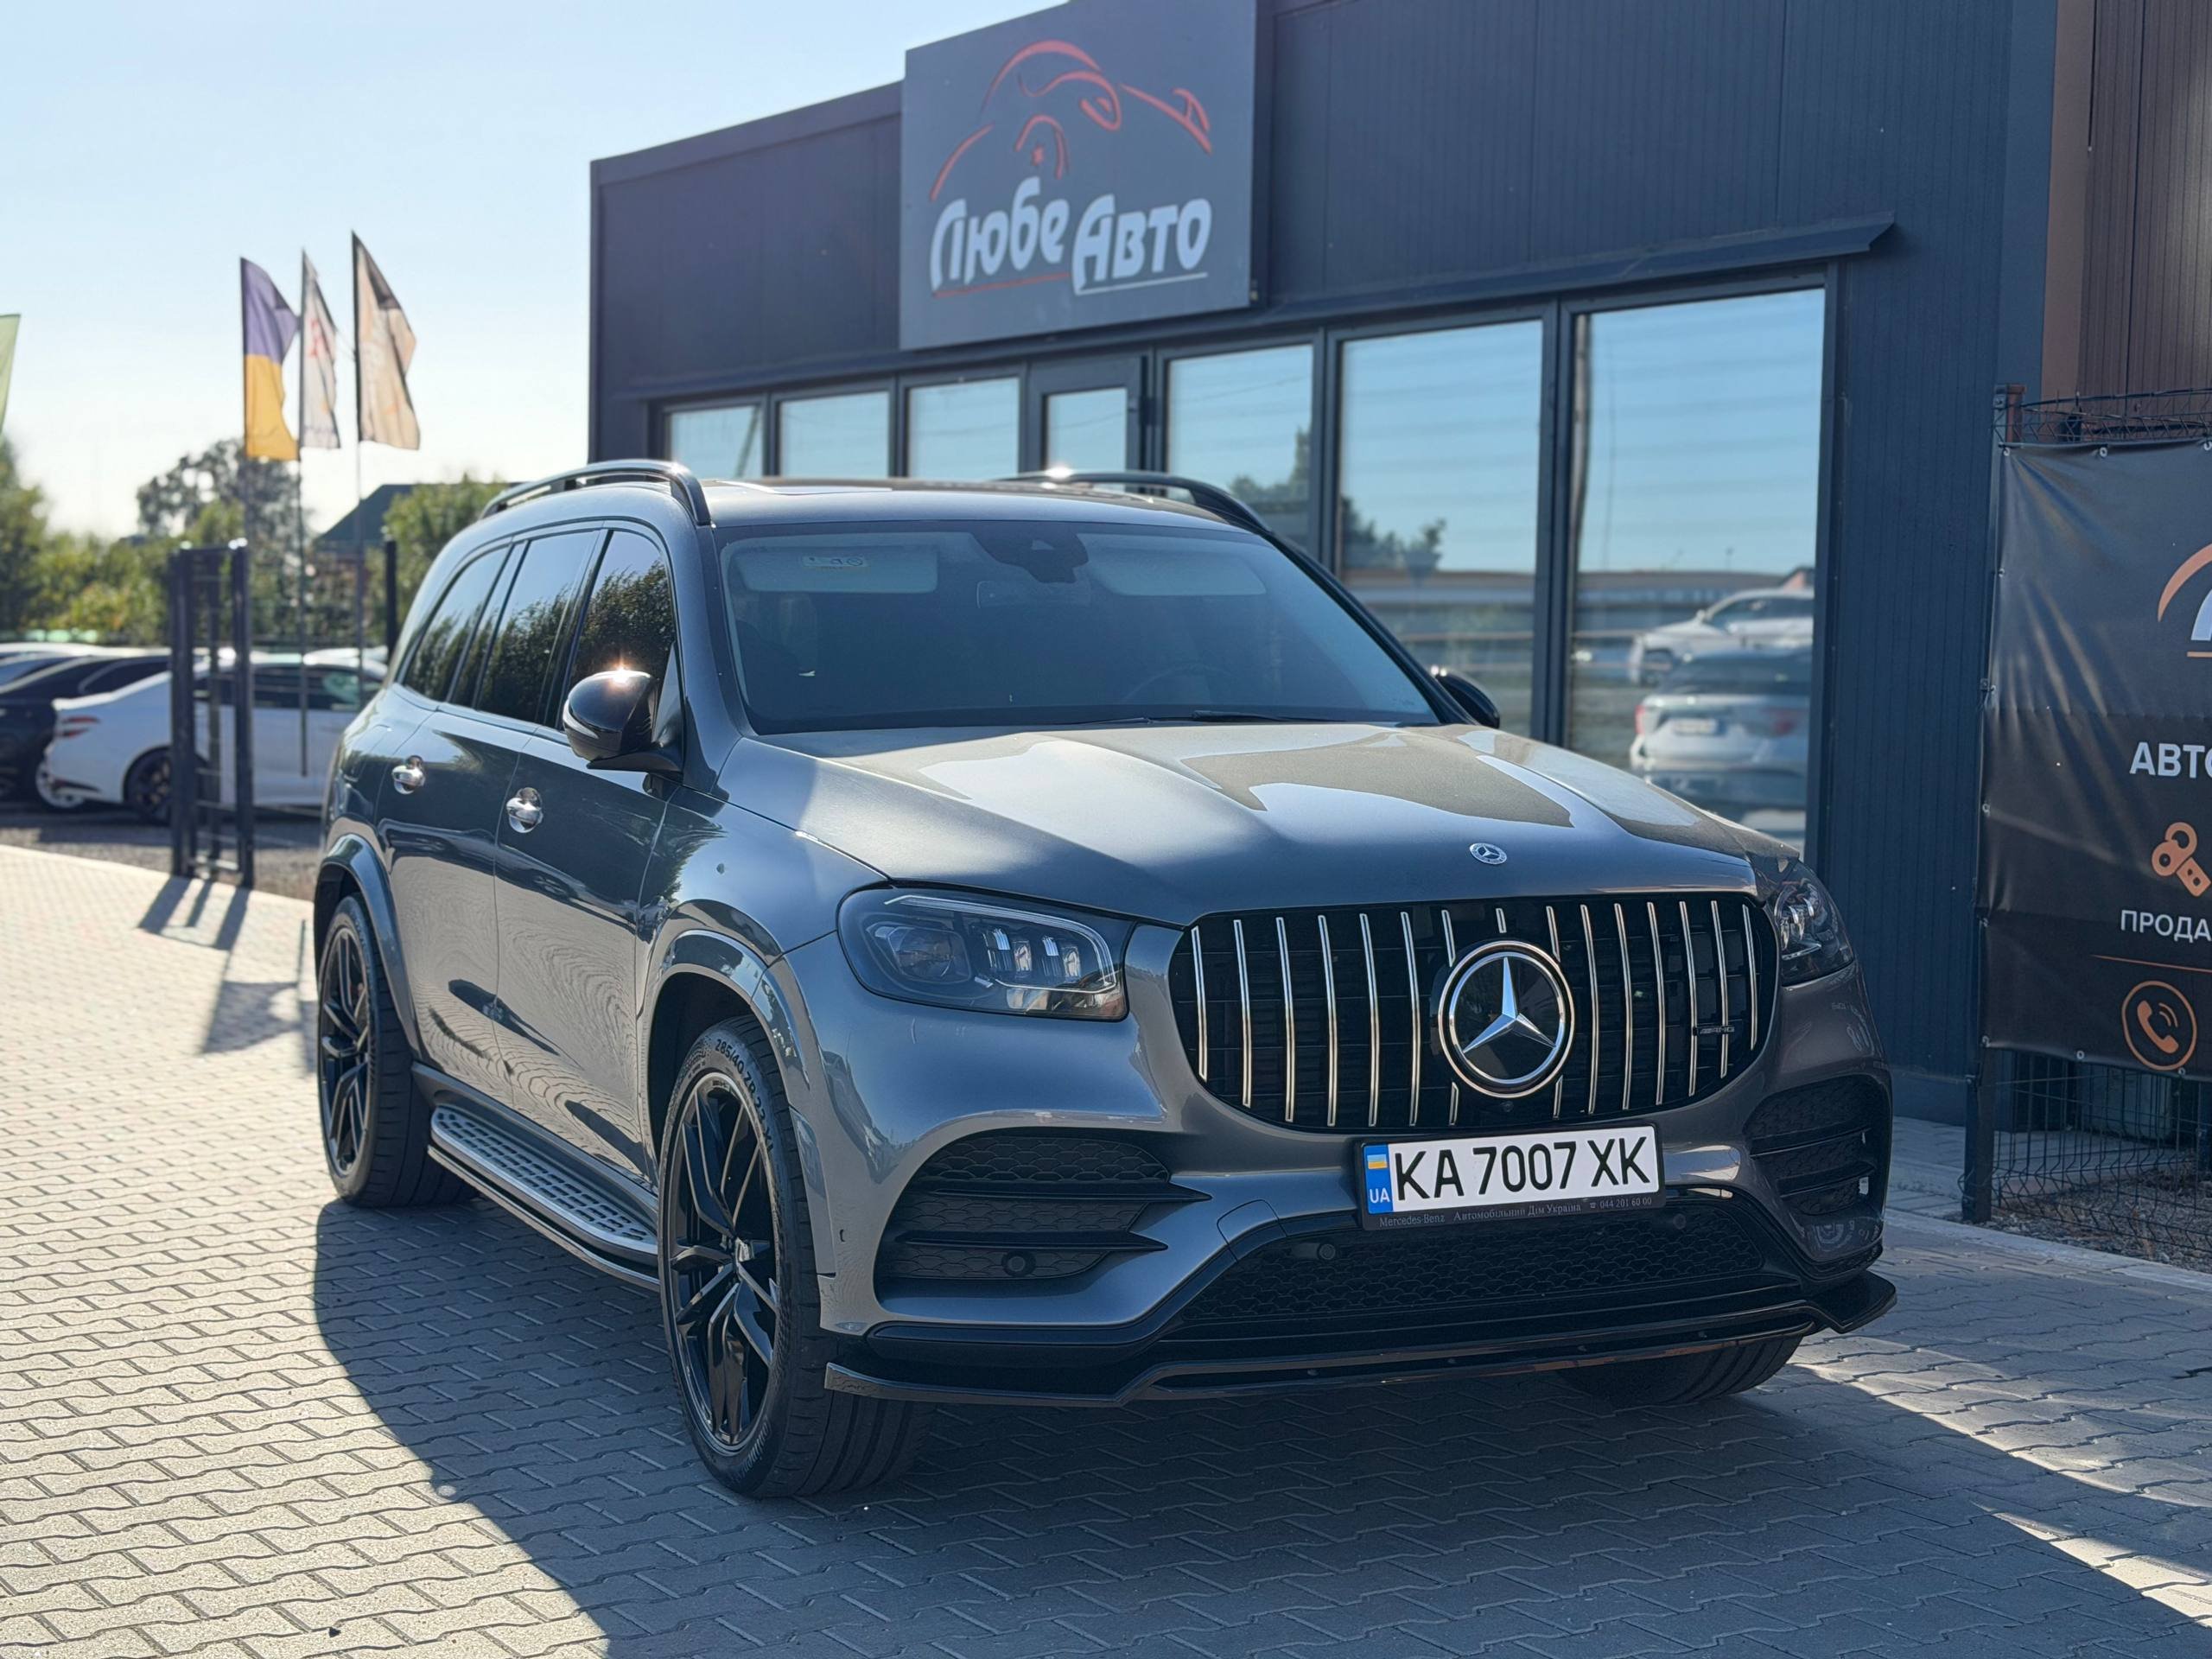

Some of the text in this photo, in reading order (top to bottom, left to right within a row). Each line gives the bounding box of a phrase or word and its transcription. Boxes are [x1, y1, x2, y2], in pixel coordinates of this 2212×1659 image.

[930, 176, 1212, 296] Любе Авто
[2129, 741, 2212, 779] АВТ
[1395, 1136, 1651, 1201] KA 7007 XK
[1369, 1187, 1391, 1204] UA
[1379, 1213, 1446, 1228] Mercedes-Benz
